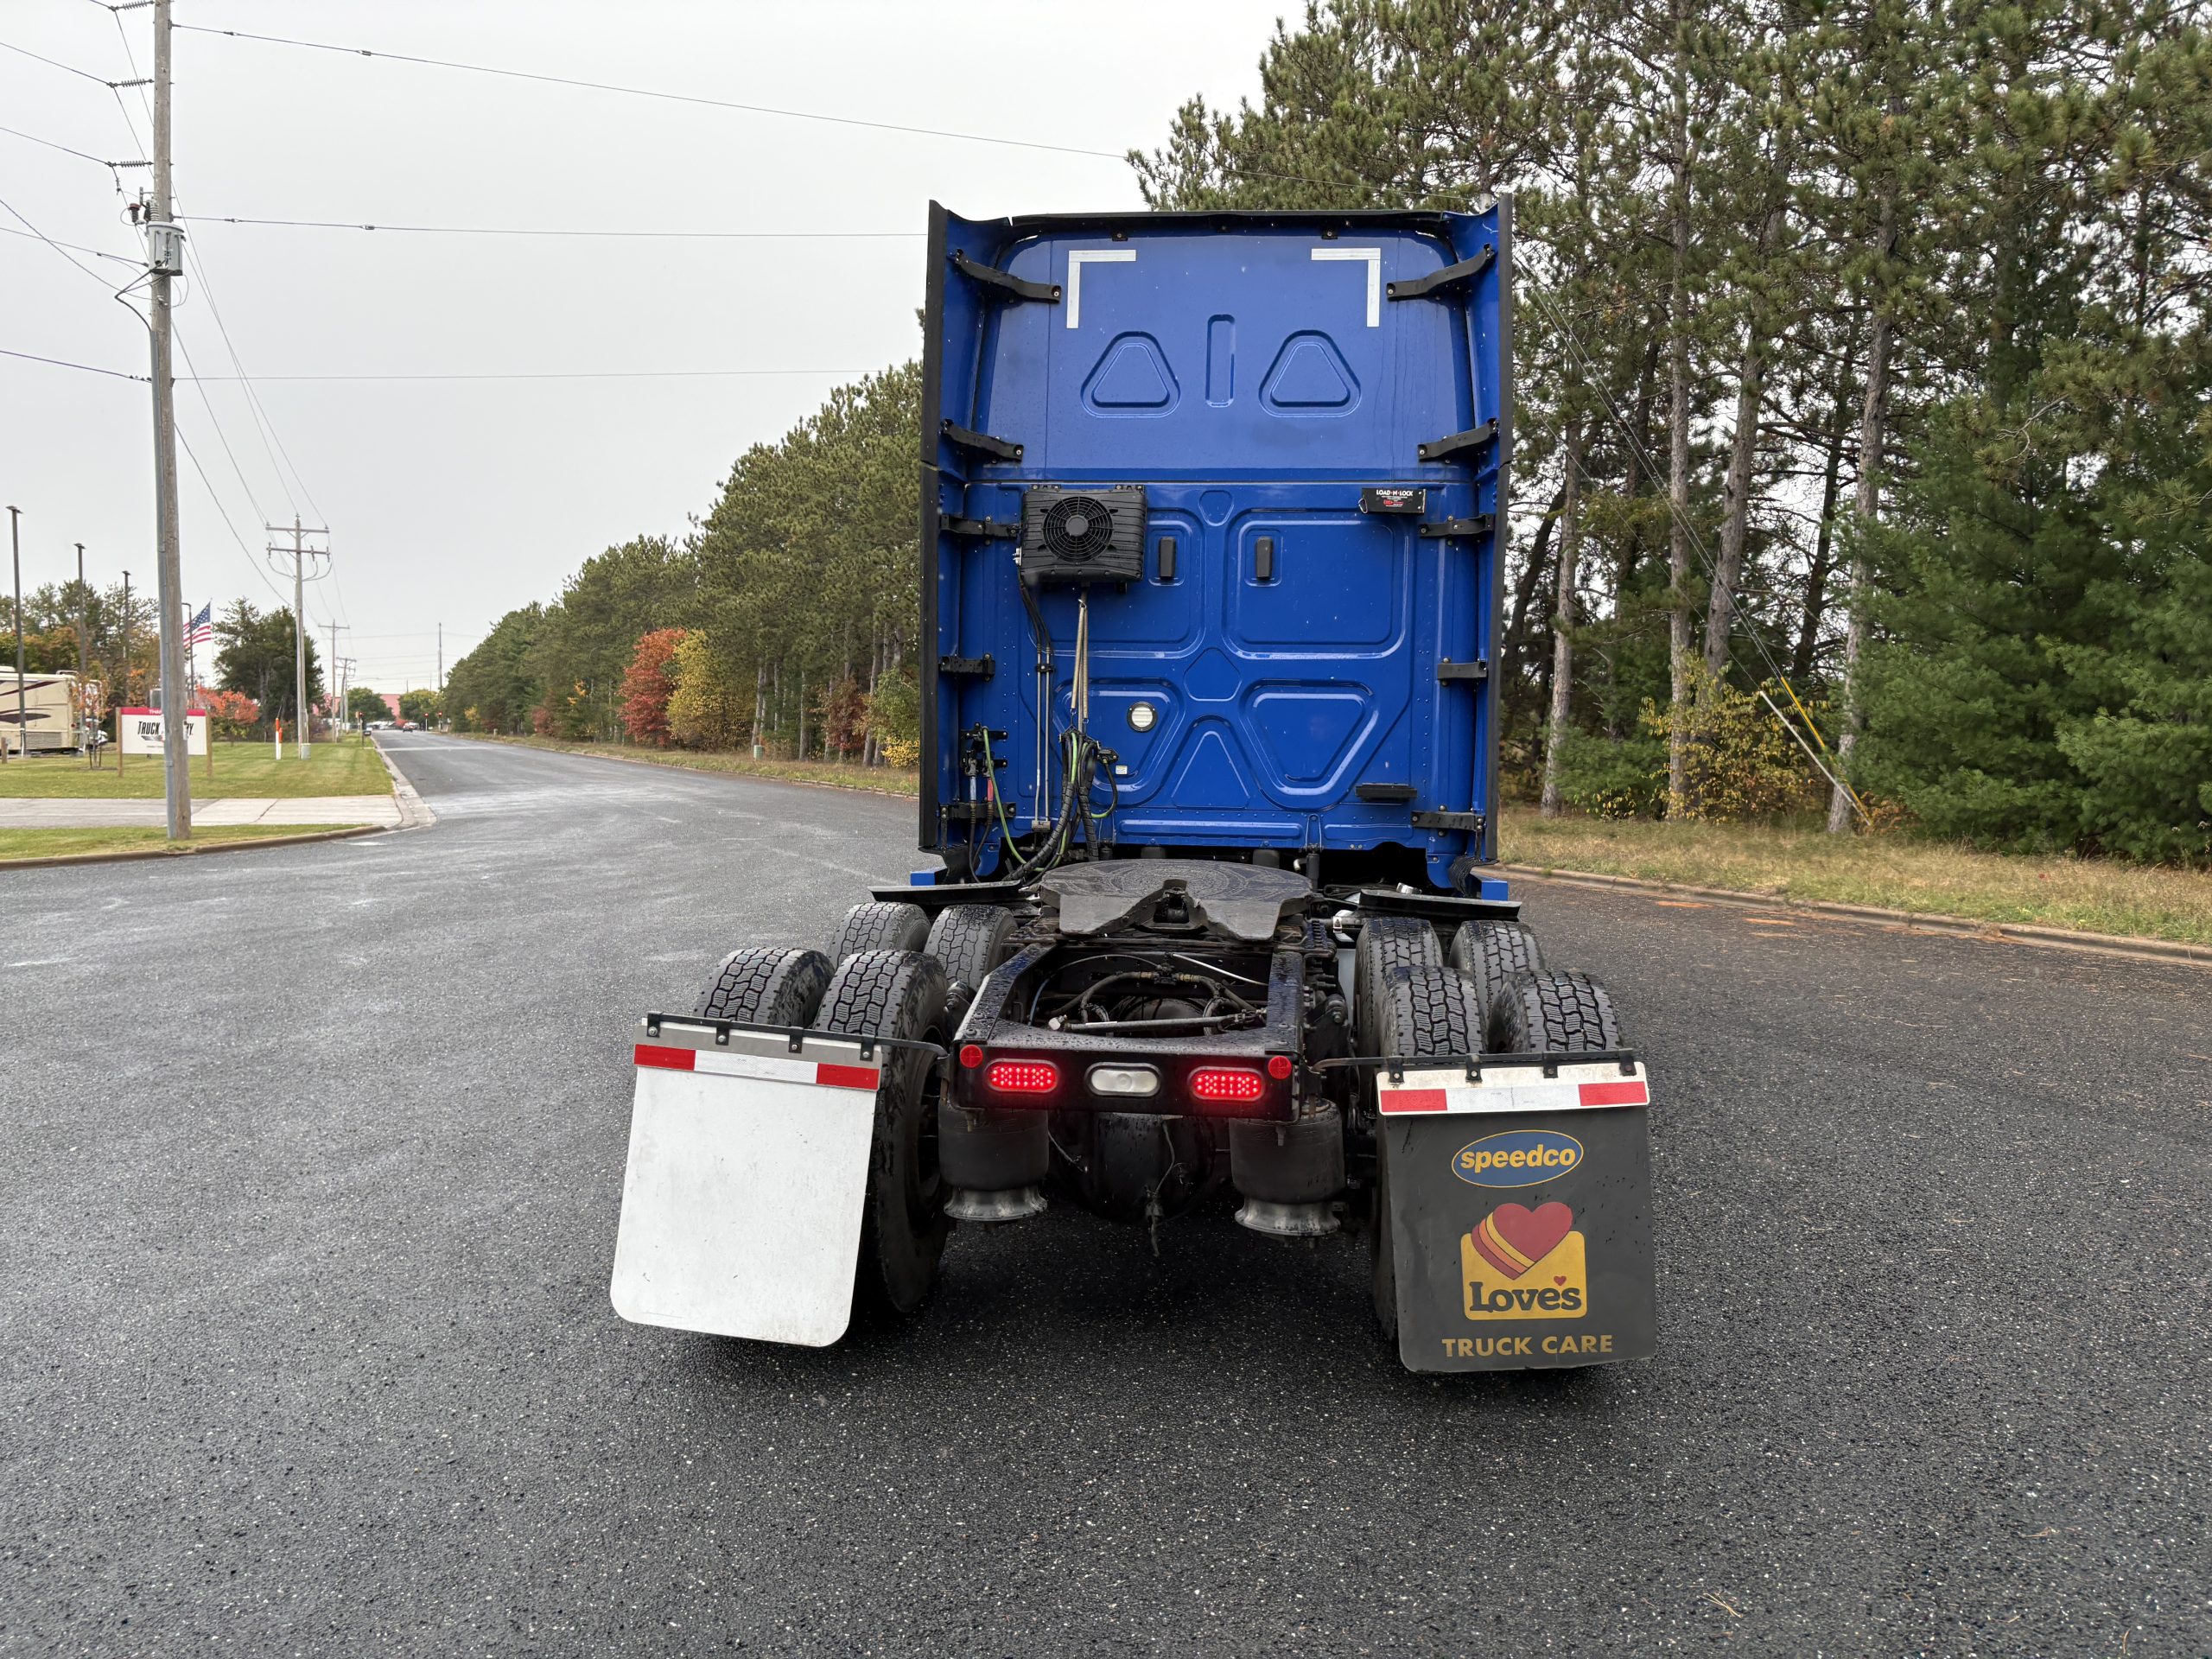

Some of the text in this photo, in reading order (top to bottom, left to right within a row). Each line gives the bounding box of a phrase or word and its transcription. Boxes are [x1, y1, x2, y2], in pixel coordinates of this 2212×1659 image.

[137, 721, 161, 734] TRUCK
[1460, 1143, 1576, 1173] speedco
[1441, 1334, 1613, 1357] TRUCK CARE
